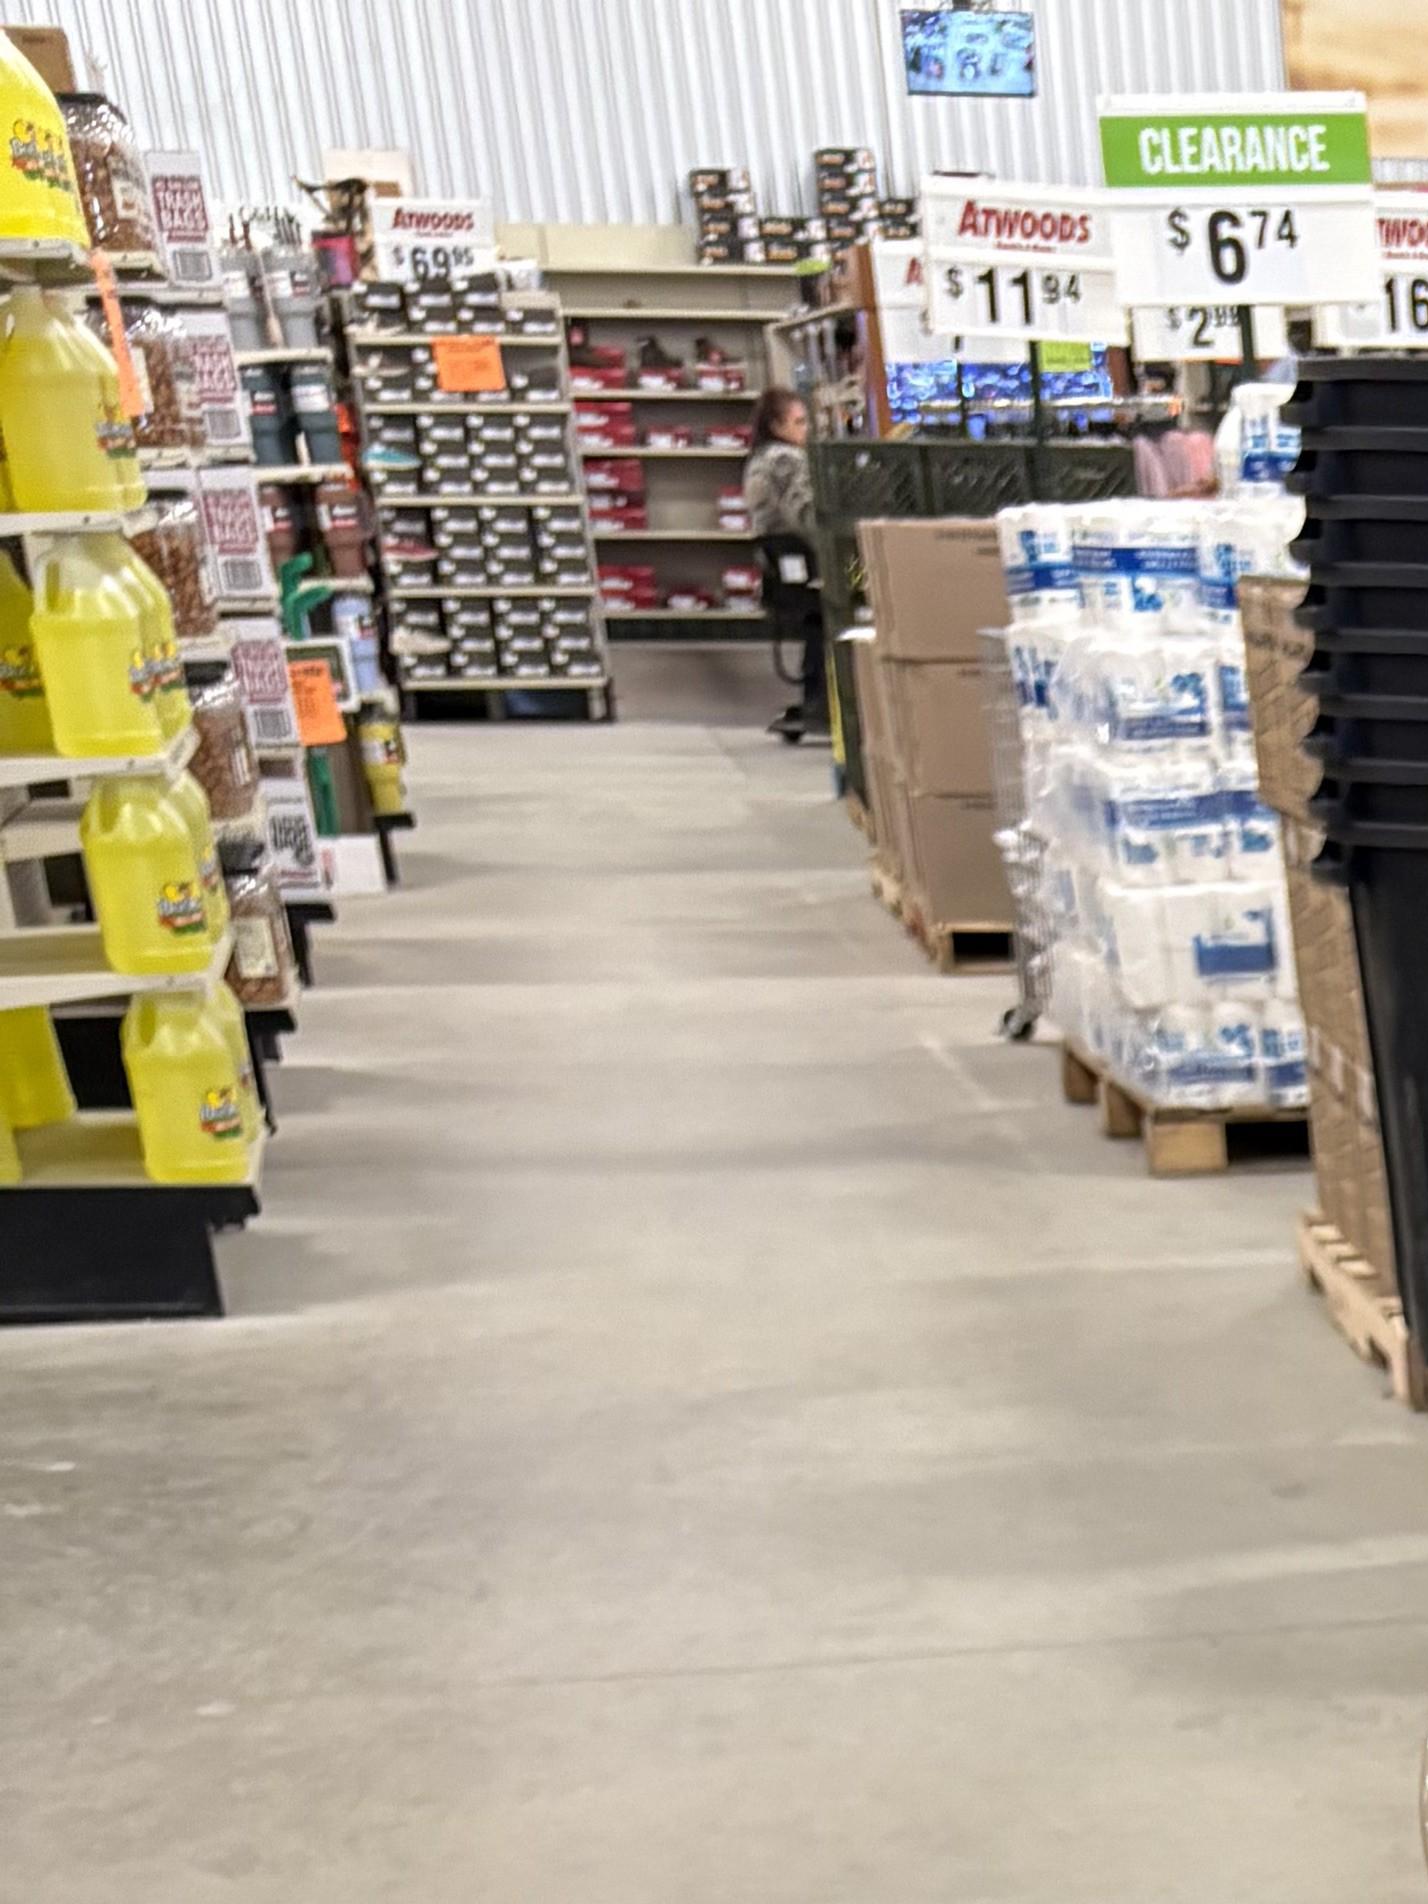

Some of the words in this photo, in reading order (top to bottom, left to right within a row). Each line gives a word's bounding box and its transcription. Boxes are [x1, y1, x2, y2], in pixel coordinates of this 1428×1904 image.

[1138, 126, 1331, 175] CLEARANCE
[392, 207, 474, 231] ATWOODS
[958, 199, 1091, 243] ATWOODS
